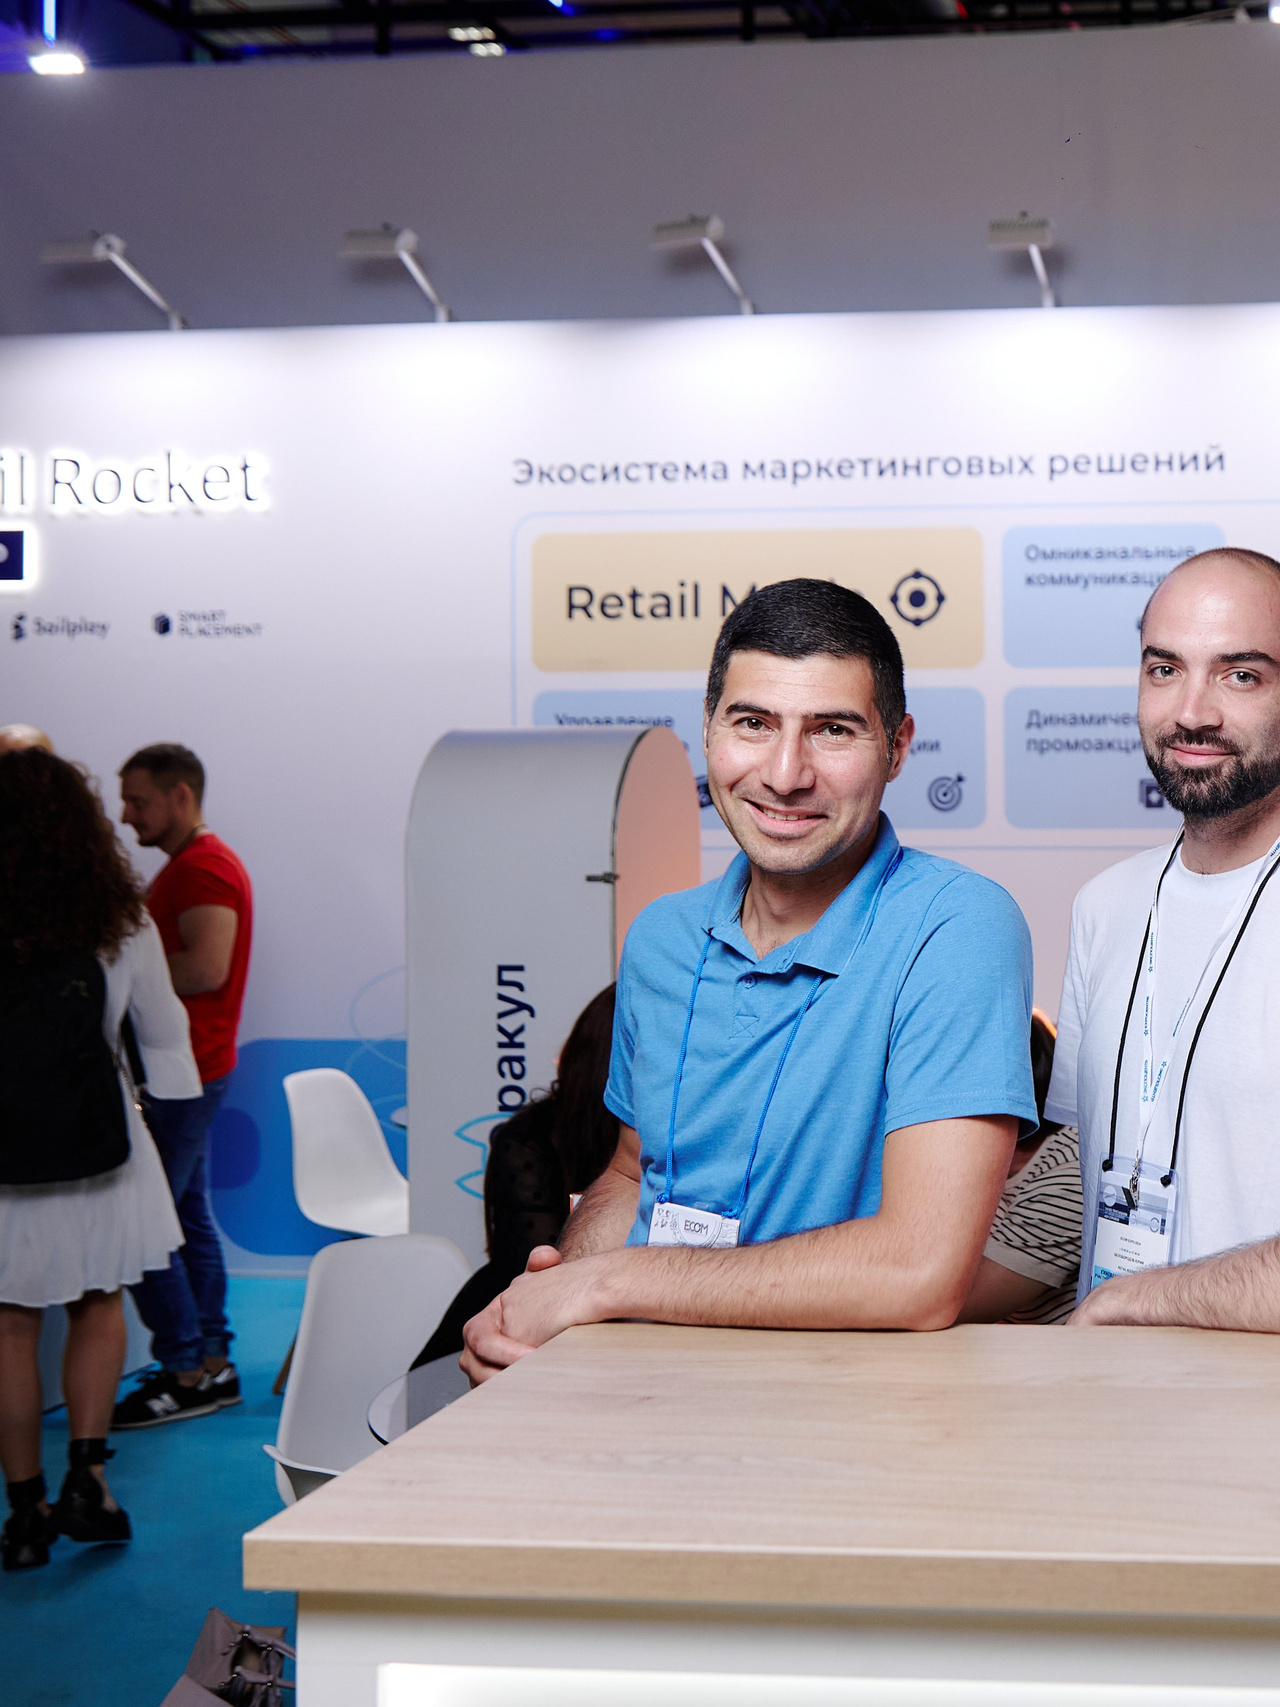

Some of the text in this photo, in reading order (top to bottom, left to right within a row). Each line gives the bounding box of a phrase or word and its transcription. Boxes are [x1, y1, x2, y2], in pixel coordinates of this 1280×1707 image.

[52, 449, 258, 505] Rocket
[513, 443, 1225, 484] Экосистема маркетинговых решений
[1024, 544, 1197, 562] Омниканальные
[567, 581, 699, 619] Retail
[1026, 709, 1138, 730] Динамичес
[1026, 738, 1143, 755] промоакци
[490, 964, 536, 1145] ракул
